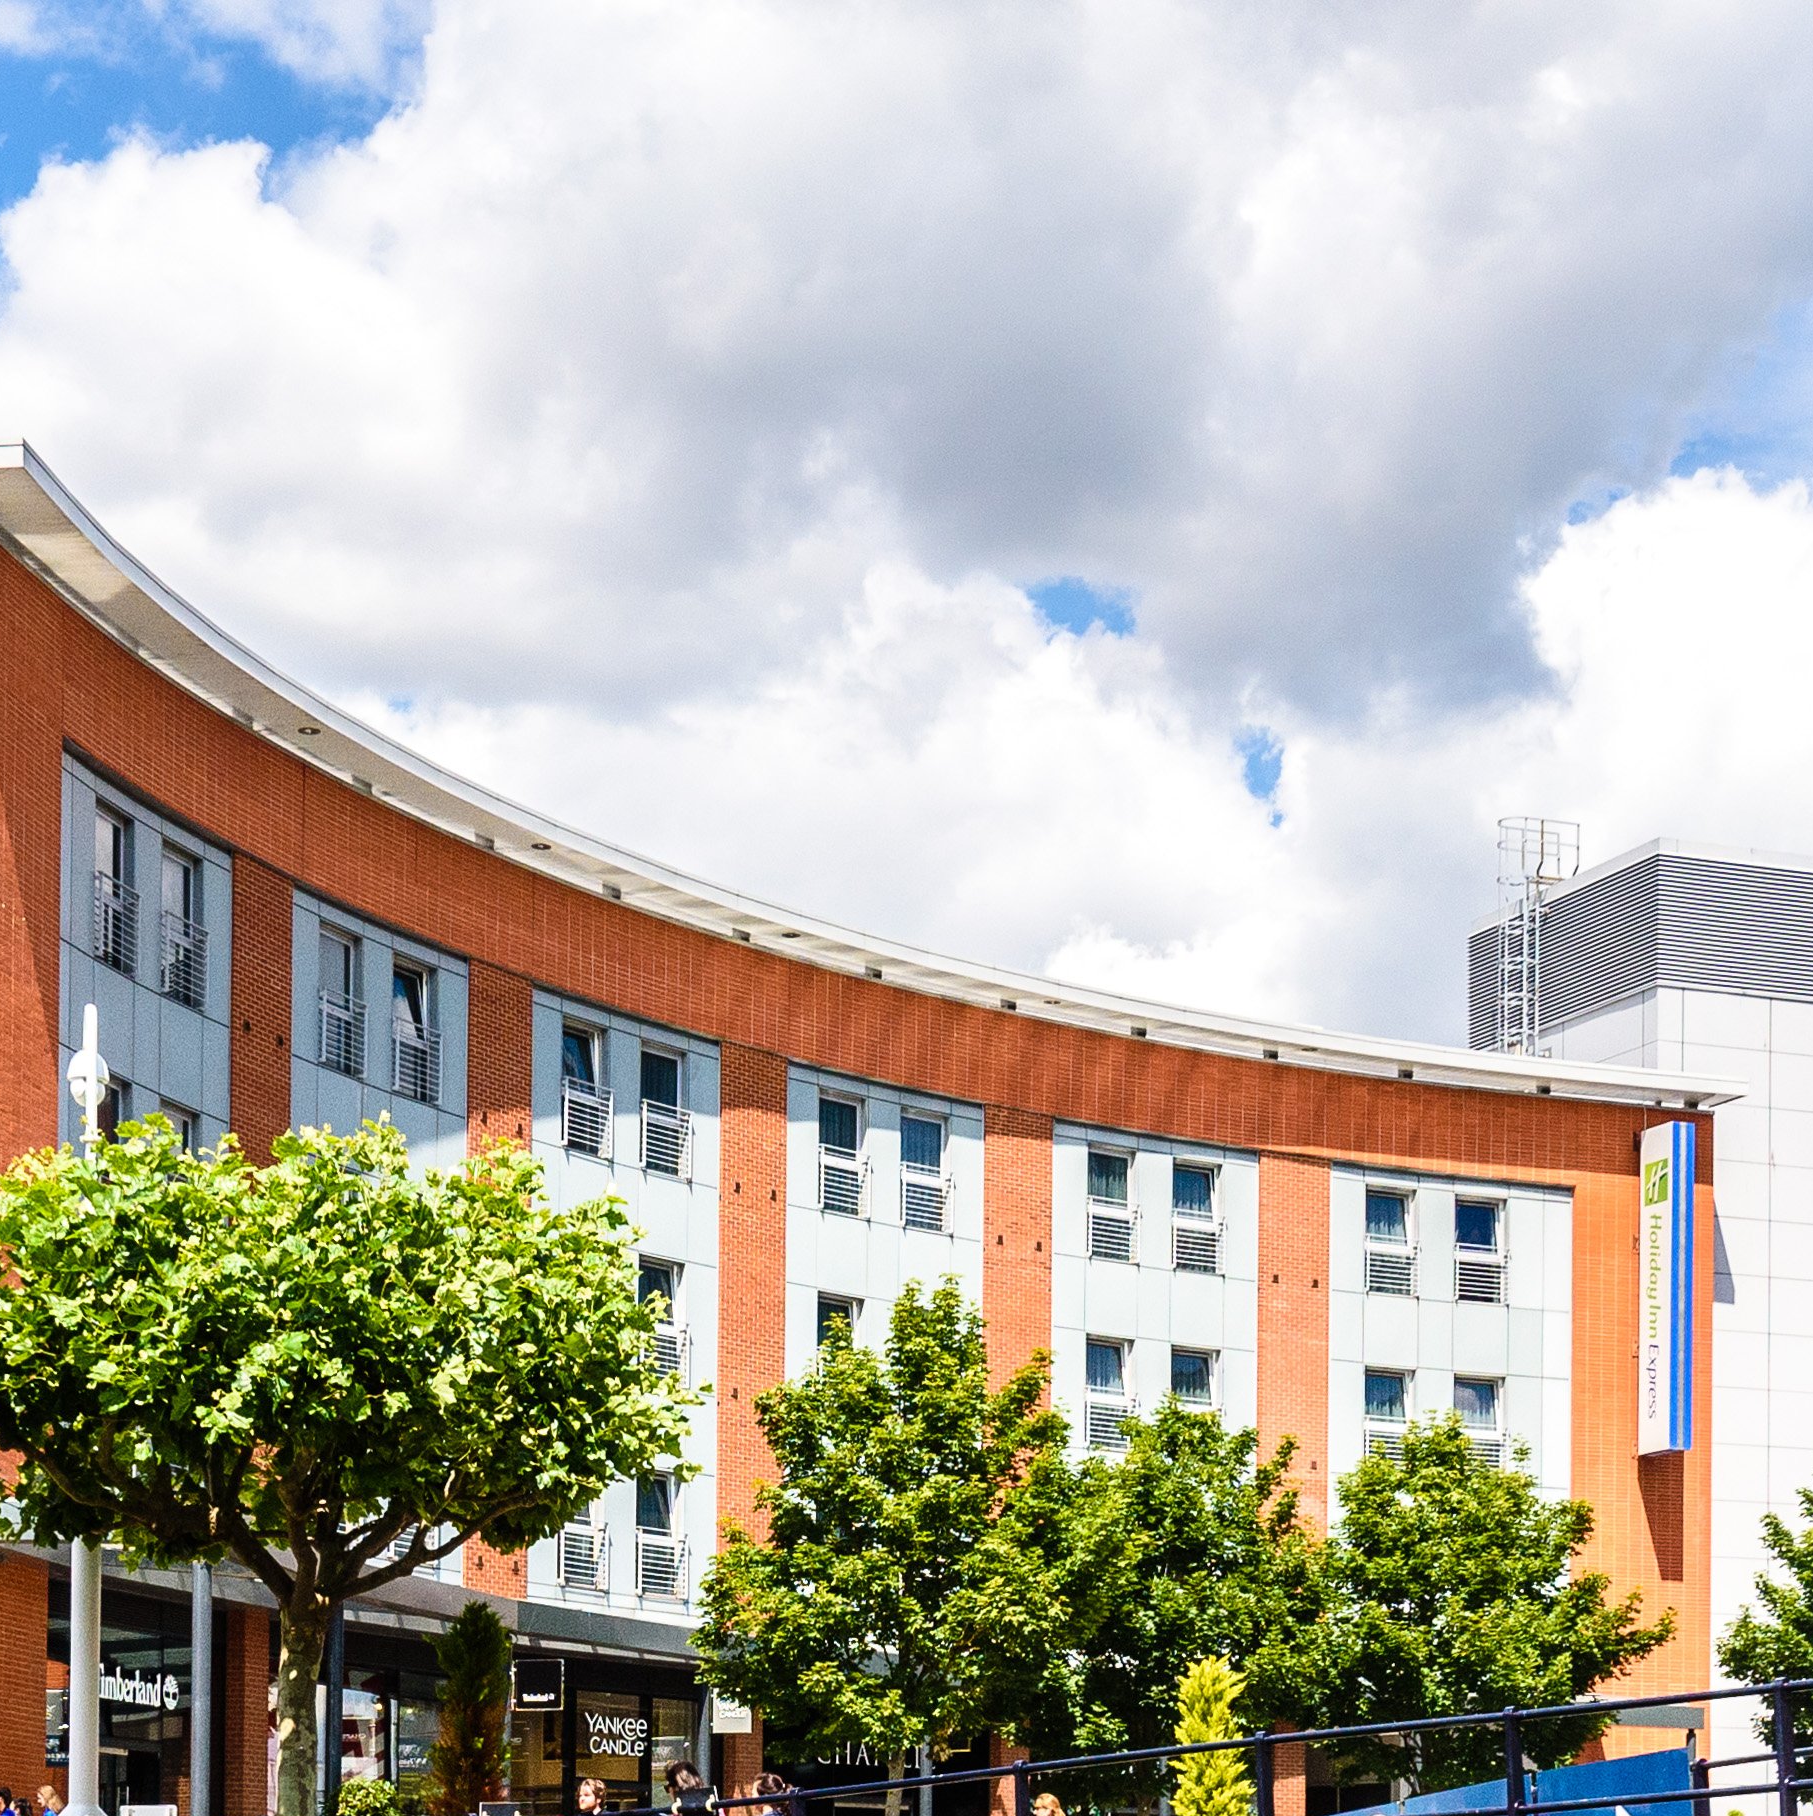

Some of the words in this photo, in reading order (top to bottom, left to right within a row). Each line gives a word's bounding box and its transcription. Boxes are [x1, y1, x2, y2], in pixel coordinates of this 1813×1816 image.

[1645, 1213, 1662, 1300] Holiday
[1648, 1305, 1662, 1339] Inn
[1647, 1344, 1659, 1420] Express
[584, 1712, 649, 1741] YANKee
[589, 1735, 645, 1758] CANDLe
